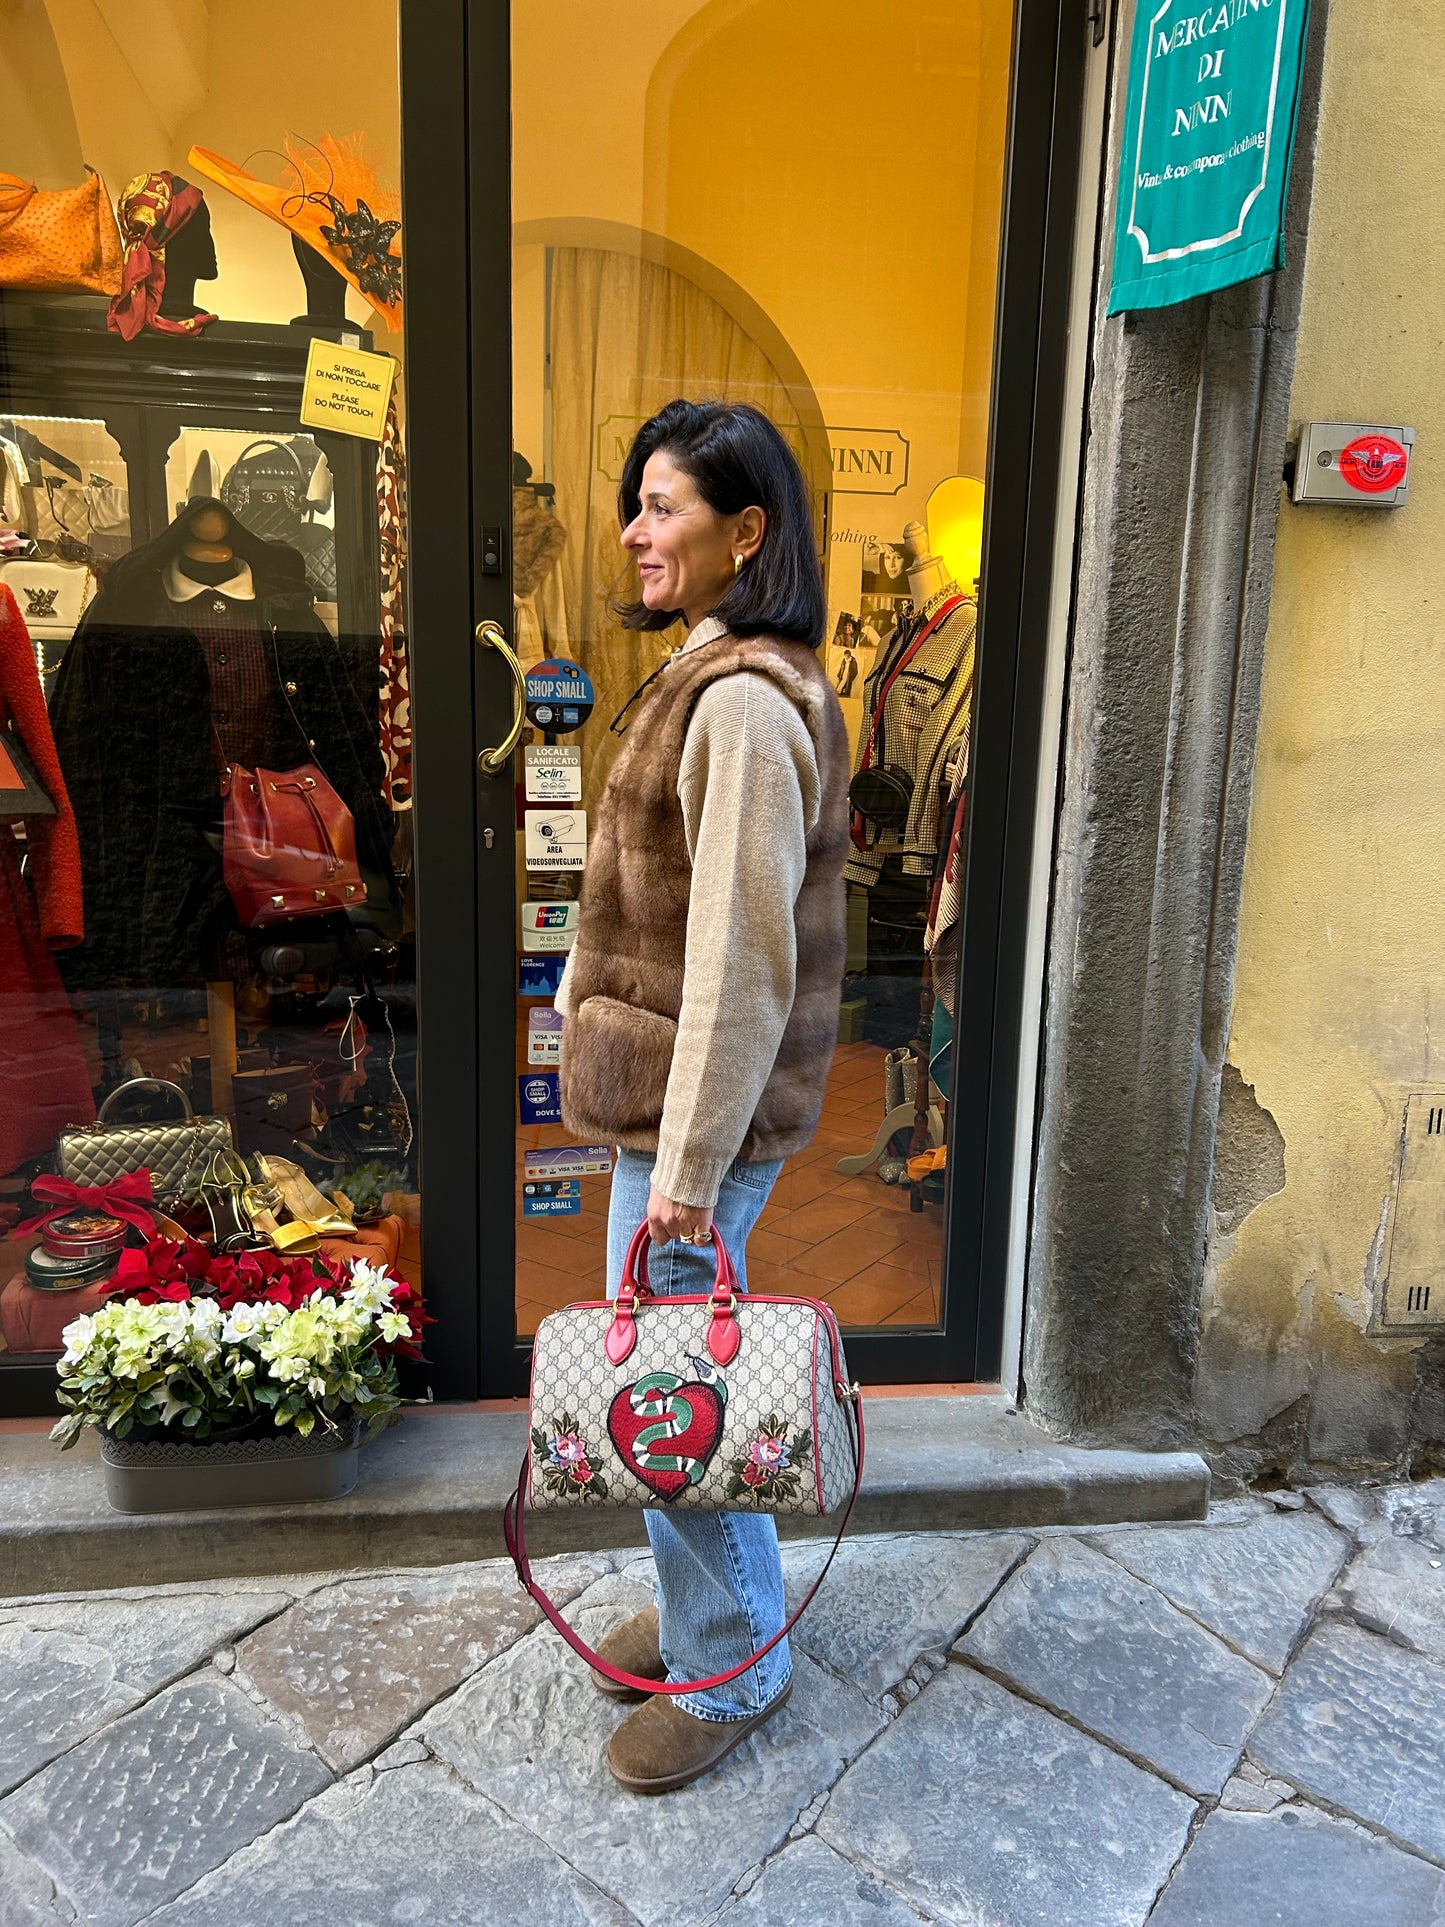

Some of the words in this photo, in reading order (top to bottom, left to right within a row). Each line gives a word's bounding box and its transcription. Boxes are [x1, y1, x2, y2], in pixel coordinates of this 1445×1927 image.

[1196, 49, 1226, 84] DI
[1163, 164, 1174, 180] &
[334, 364, 341, 372] SI
[342, 366, 366, 378] PREGA
[316, 369, 324, 378] DI
[325, 373, 343, 383] NON
[345, 376, 381, 391] TOCCARE
[332, 393, 359, 405] PLEASE
[315, 398, 327, 407] DO
[328, 402, 345, 411] NOT
[347, 405, 374, 418] TOUCH
[821, 447, 894, 475] NINNI
[528, 680, 553, 698] SHOP
[556, 681, 587, 699] SMALL
[536, 748, 570, 756] LOCALE
[528, 757, 579, 765] SANIFICATO
[546, 846, 563, 854] AREA
[526, 858, 583, 866] VIDEOSORVEGLIATA
[535, 1109, 555, 1117] DOVE
[531, 1202, 550, 1211] SHOP
[550, 1201, 573, 1210] SMALL
